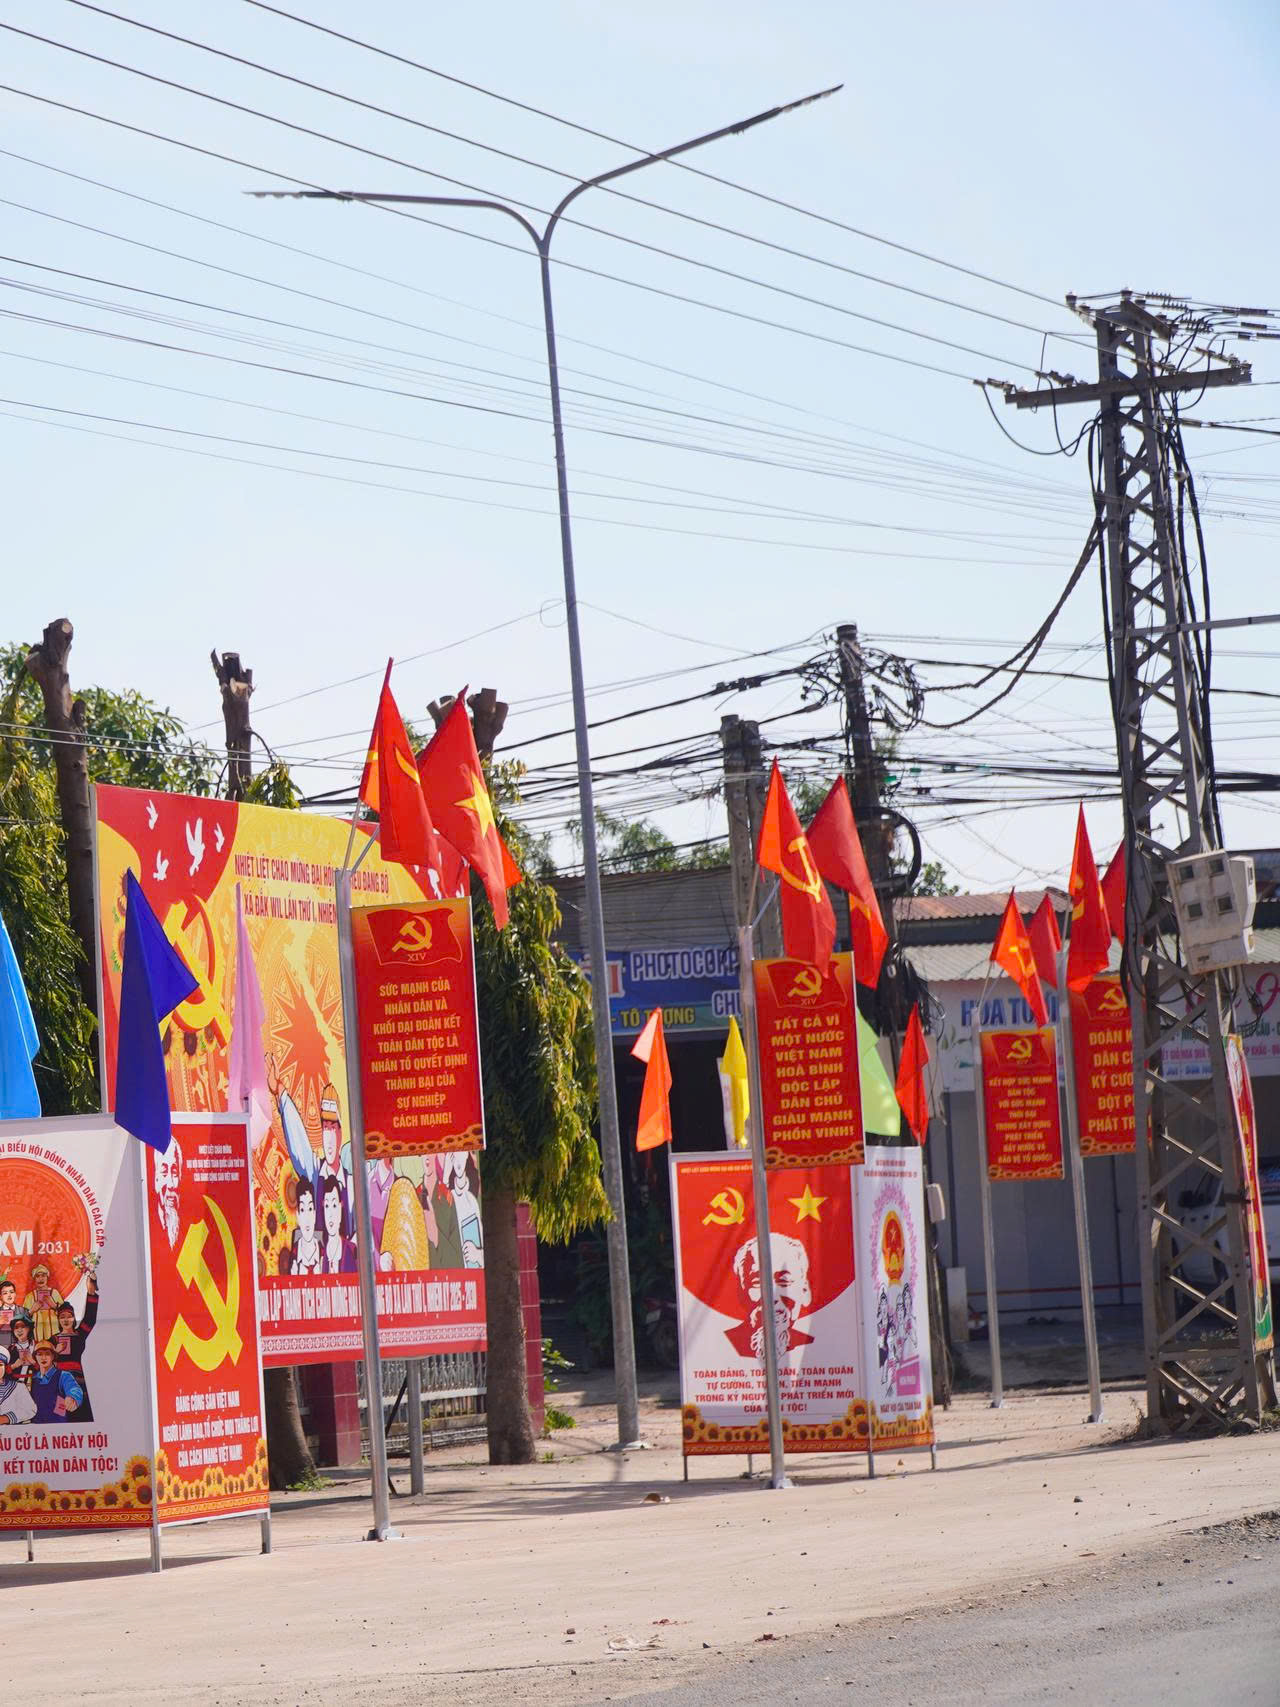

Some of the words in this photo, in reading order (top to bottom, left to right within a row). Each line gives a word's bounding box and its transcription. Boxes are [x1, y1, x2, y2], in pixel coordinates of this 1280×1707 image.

[407, 952, 427, 962] XIV
[379, 982, 398, 997] SỨC
[400, 981, 429, 996] MẠNH
[431, 976, 451, 992] CỦA
[384, 1000, 411, 1016] NHÂN
[413, 998, 433, 1013] DÂN
[435, 996, 448, 1011] VÀ
[373, 1017, 396, 1035] KHỐI
[398, 1020, 414, 1035] ĐẠI
[416, 1016, 441, 1032] ĐOÀN
[443, 1012, 461, 1029] KẾT
[774, 1015, 799, 1031] TẤT
[803, 1013, 822, 1028] CẢ
[826, 1012, 840, 1026] VÌ
[378, 1038, 403, 1054] TOÀN
[405, 1037, 425, 1052] DÂN
[426, 1035, 445, 1052] TỘC
[446, 1033, 459, 1048] LÀ
[771, 1033, 801, 1047] MỘT
[806, 1030, 844, 1044] NƯỚC
[371, 1058, 398, 1073] NHÂN
[413, 1052, 443, 1071] QUYẾT
[444, 1053, 468, 1069] ĐỊNH
[776, 1048, 805, 1063] VIỆT
[809, 1047, 842, 1059] NAM
[809, 1062, 843, 1076] BÌNH
[385, 1075, 417, 1091] THÀNH
[418, 1075, 434, 1090] BẠI
[436, 1070, 456, 1087] CỦA
[781, 1079, 810, 1095] ĐỘC
[814, 1077, 840, 1092] LẬP
[411, 1091, 446, 1109] NGHIỆP
[781, 1095, 810, 1109] DÂN
[814, 1091, 843, 1107] CHỦ
[392, 1113, 418, 1128] CÁCH
[420, 1111, 452, 1128] MẠNG!
[773, 1112, 807, 1126] GIÀU
[810, 1109, 853, 1124] MẠNH
[815, 1125, 855, 1139] VINH!
[38, 1240, 70, 1255] 2031
[15, 1432, 32, 1451] CỬ
[34, 1433, 50, 1450] LÀ
[52, 1432, 84, 1449] NGÀY
[88, 1432, 108, 1451] HỘI
[3, 1456, 25, 1475] KẾT
[28, 1458, 60, 1474] TOÀN
[63, 1456, 88, 1472] DÂN
[91, 1455, 119, 1475] TỘC!
